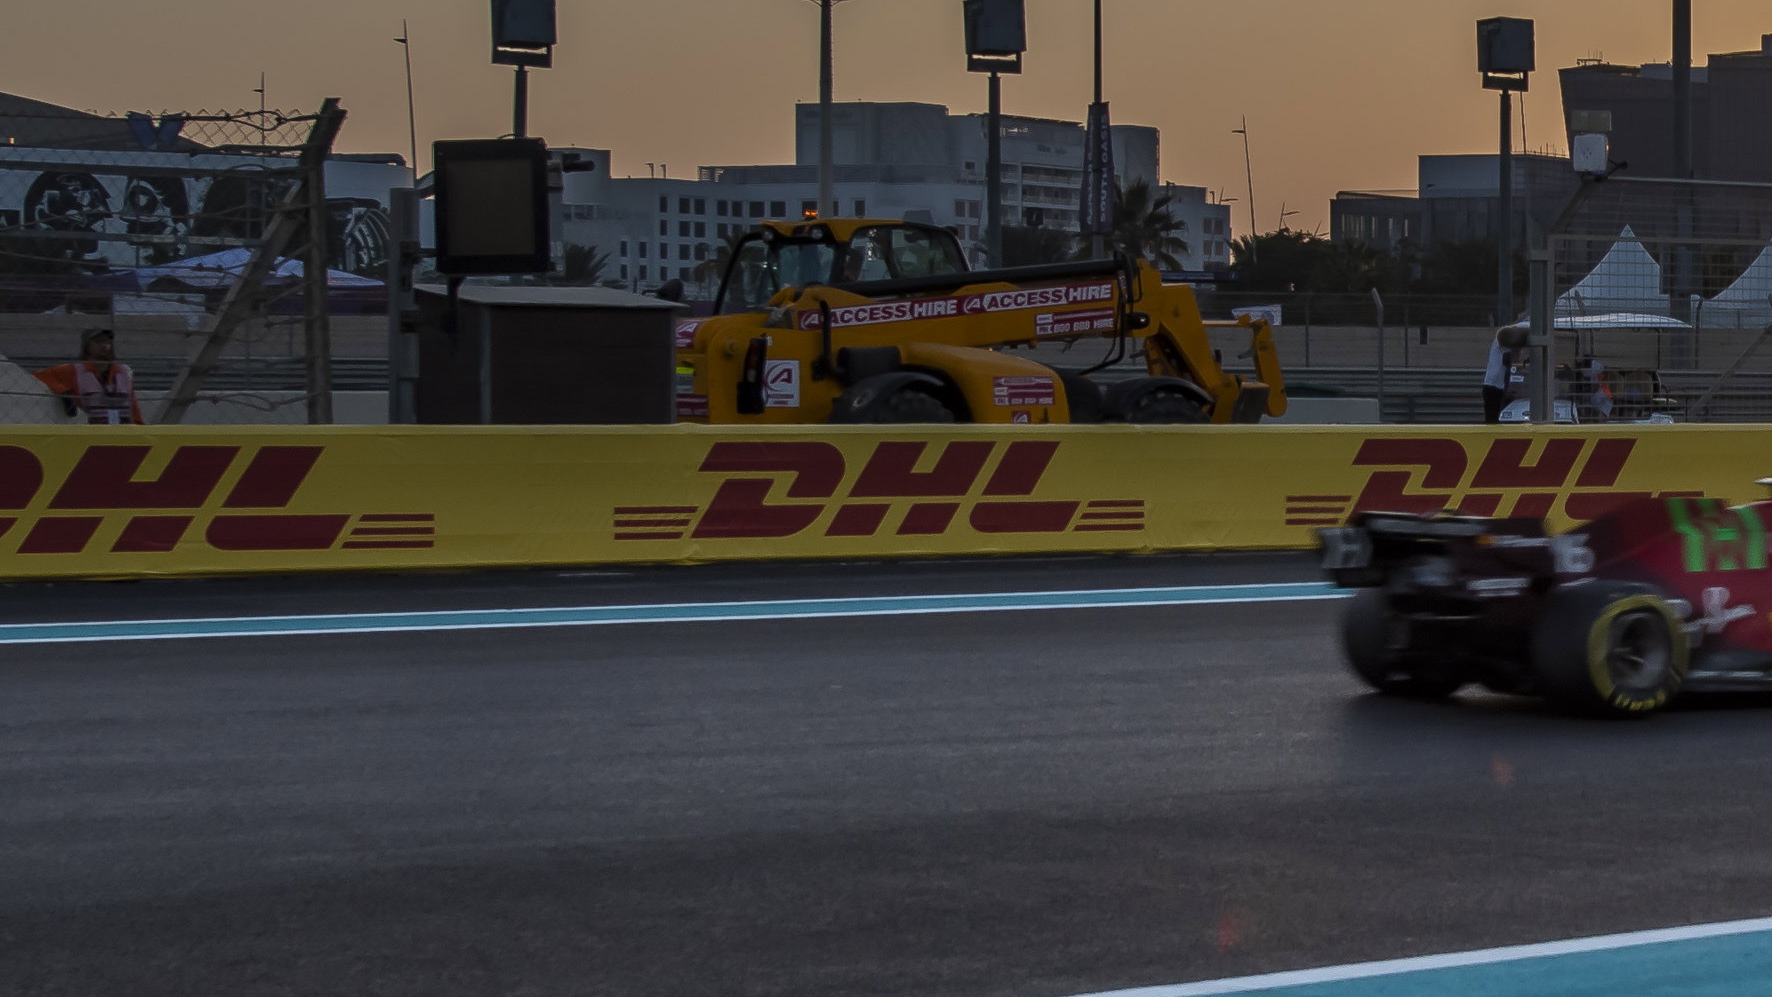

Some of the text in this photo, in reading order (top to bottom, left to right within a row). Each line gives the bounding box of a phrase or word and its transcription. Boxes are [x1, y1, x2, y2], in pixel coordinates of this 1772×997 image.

[829, 304, 908, 325] ACCESS
[914, 299, 958, 318] HIRE
[987, 291, 1064, 310] ACCESS
[1069, 284, 1112, 302] HIRE
[0, 445, 351, 554] HL
[691, 442, 1080, 539] DHL
[1352, 438, 1656, 519] DHL
